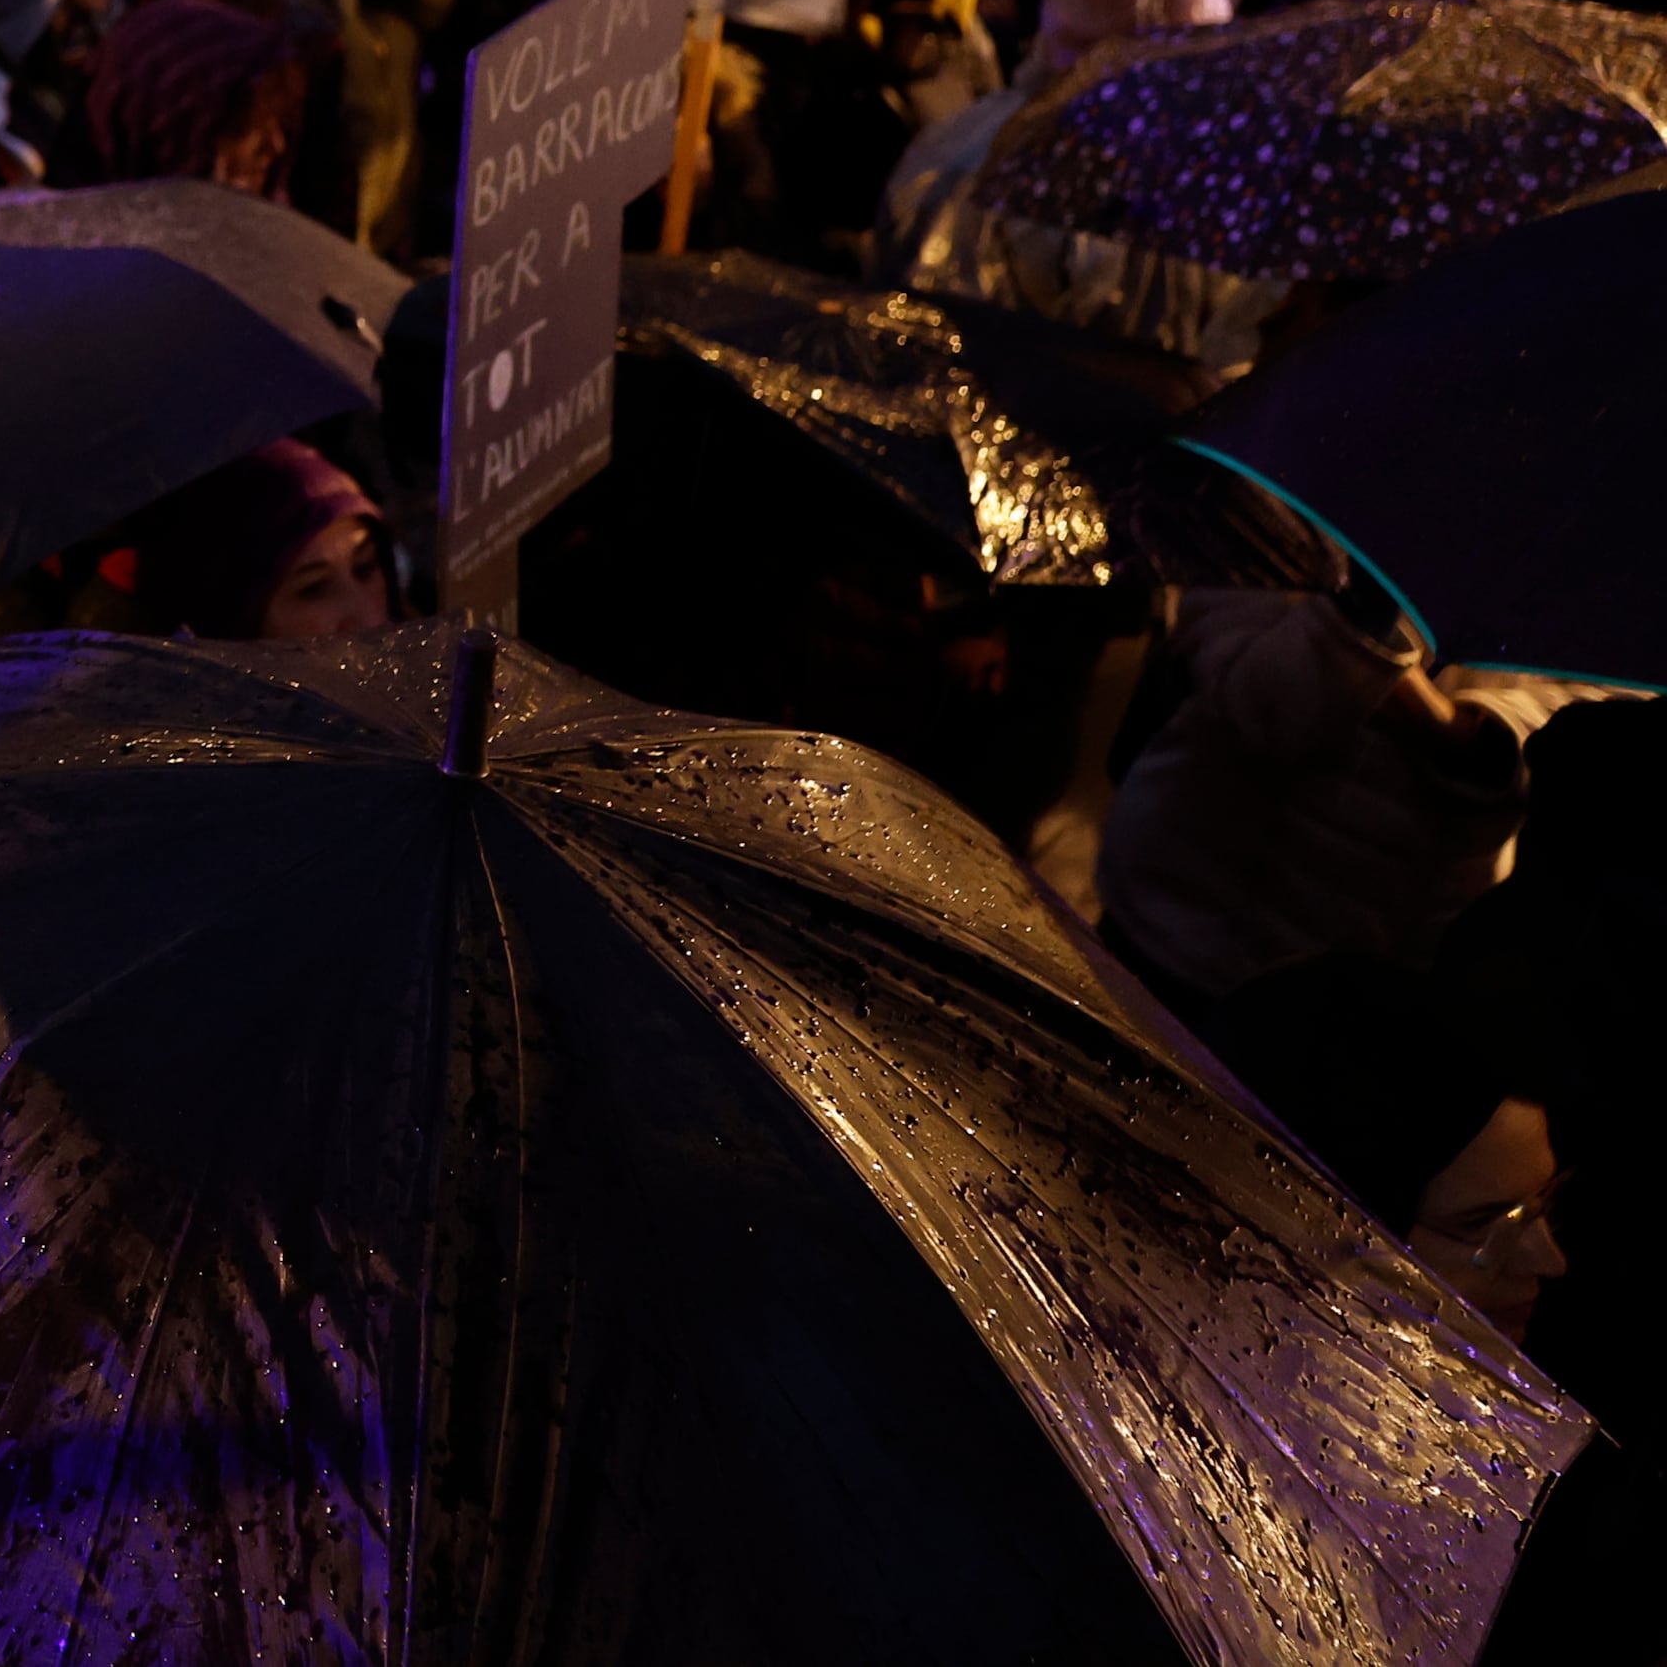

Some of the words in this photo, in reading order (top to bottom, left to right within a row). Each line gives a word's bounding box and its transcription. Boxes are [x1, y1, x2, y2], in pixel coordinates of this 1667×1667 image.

[468, 228, 541, 342] PER
[561, 200, 591, 268] A
[461, 316, 548, 430] TOT
